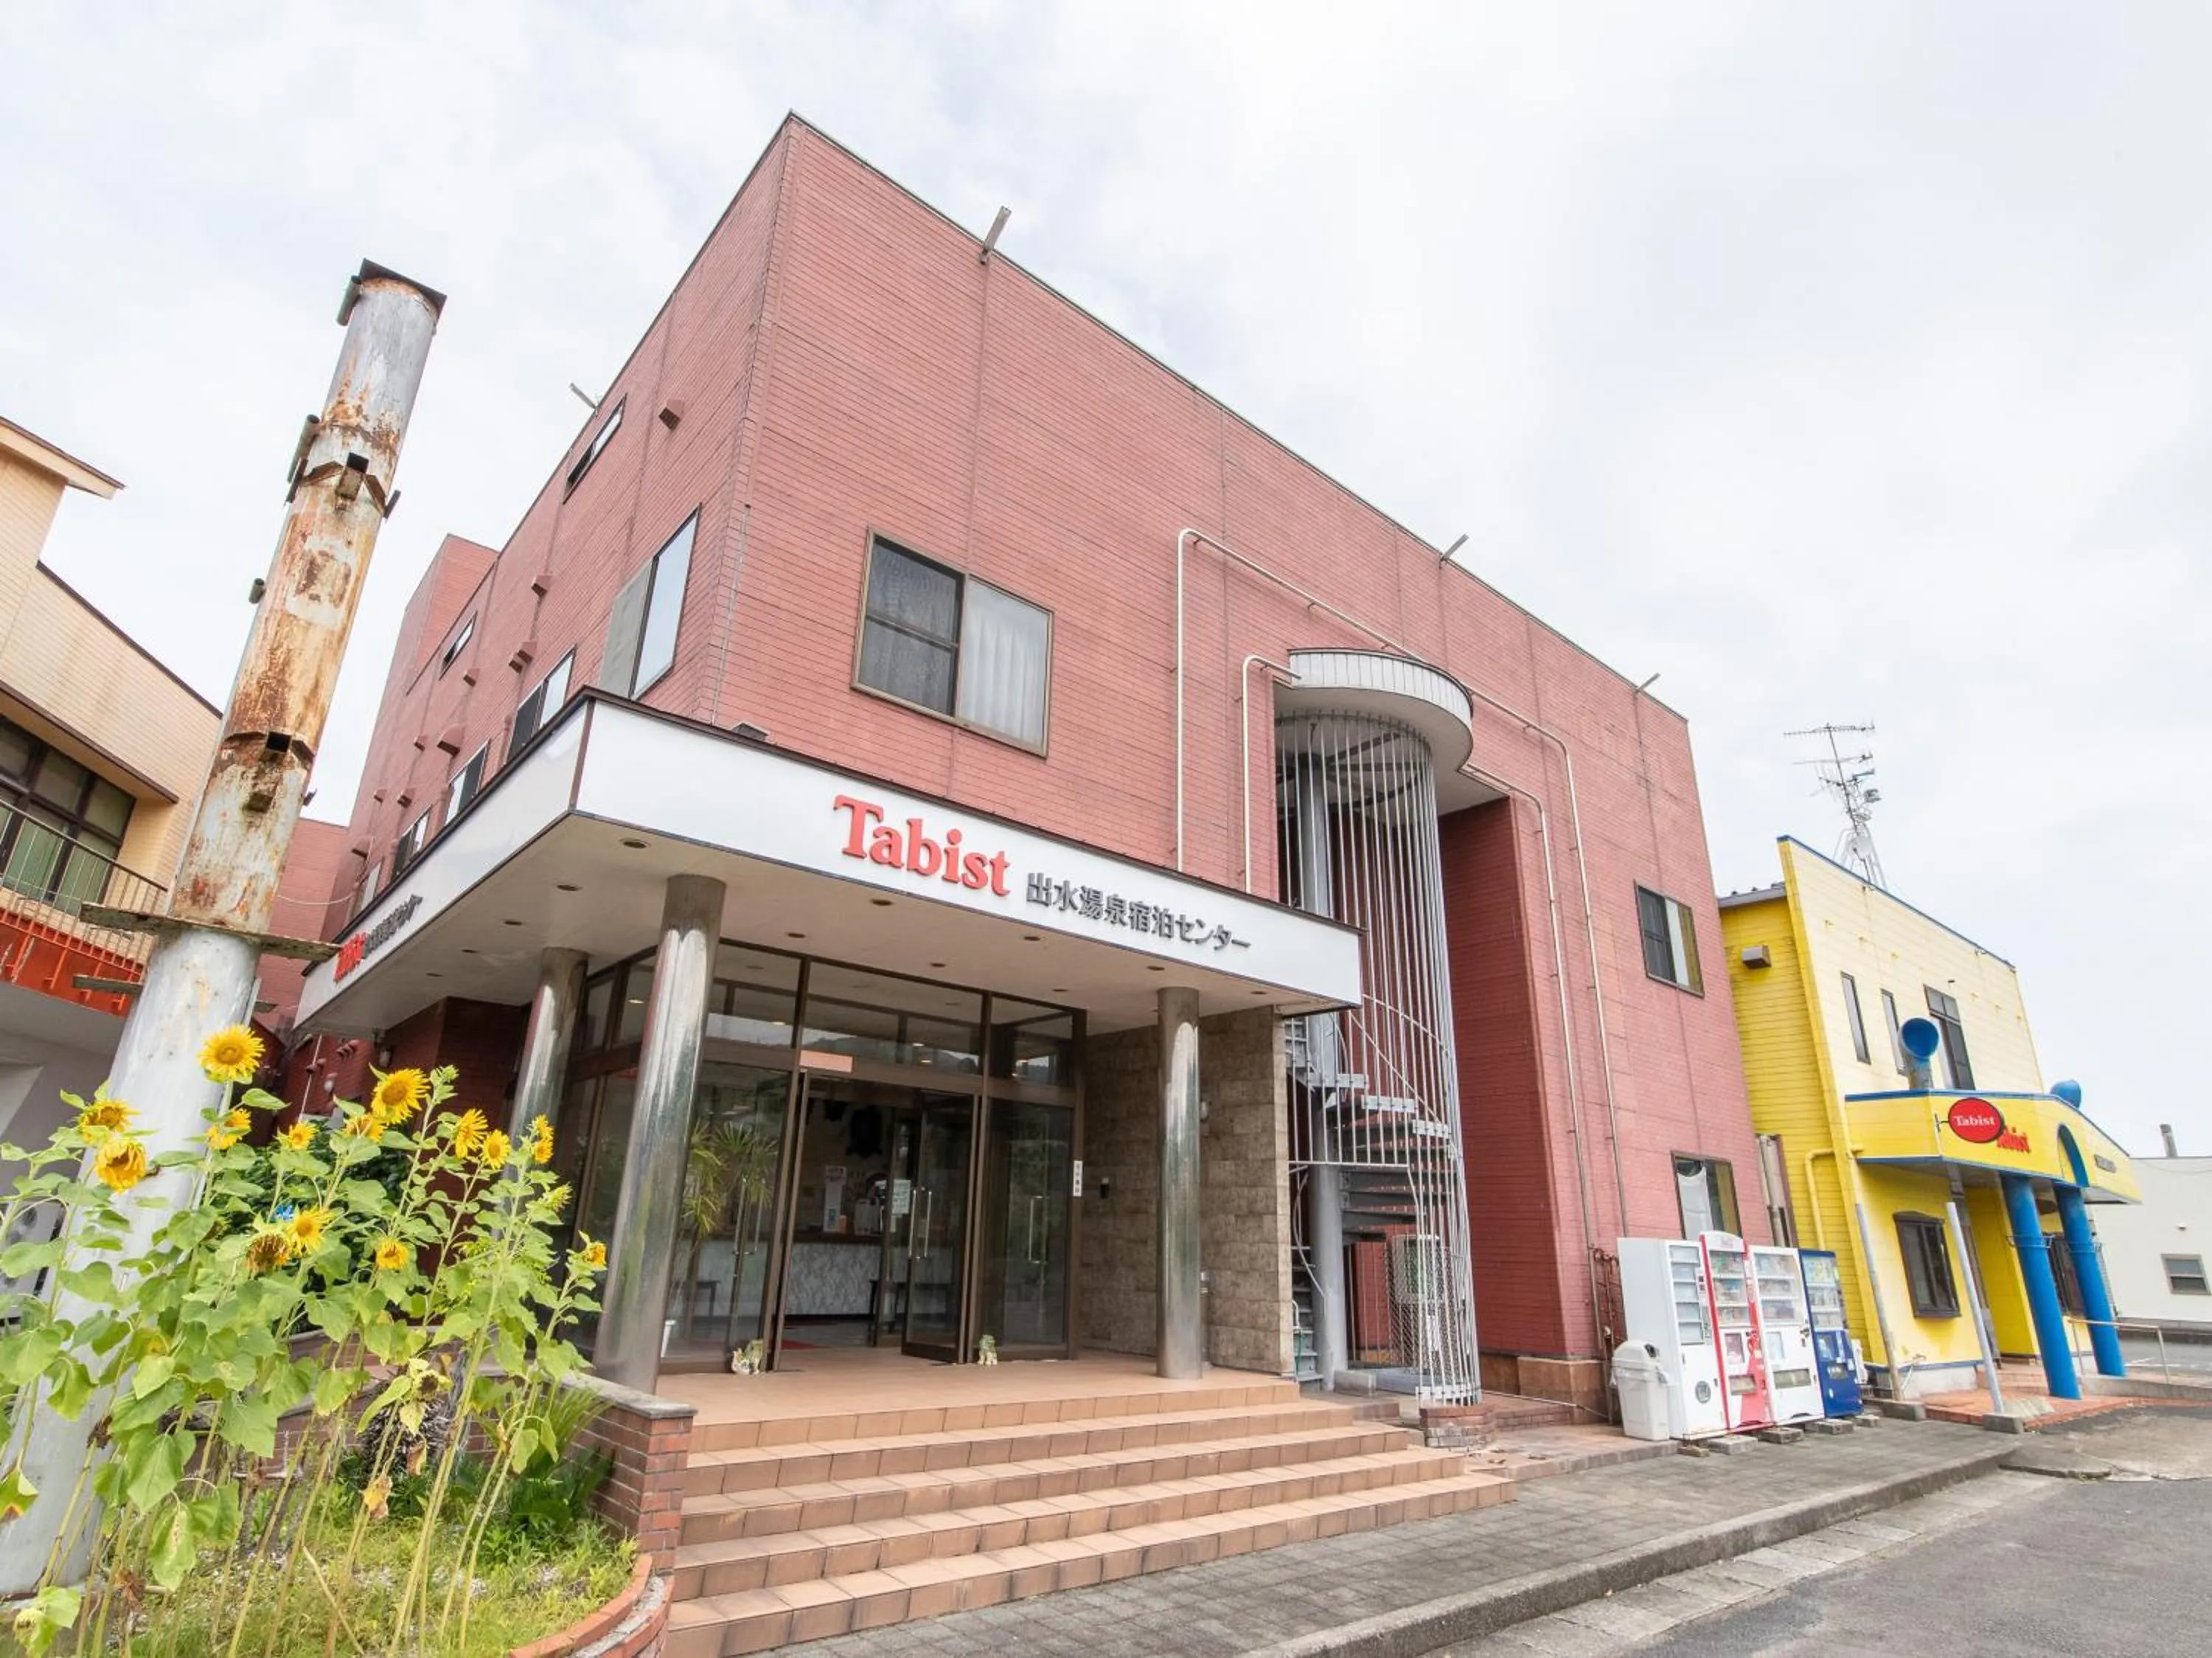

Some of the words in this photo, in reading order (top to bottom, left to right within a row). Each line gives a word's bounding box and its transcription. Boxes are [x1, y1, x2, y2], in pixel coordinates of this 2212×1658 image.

[834, 794, 1011, 896] Tabist
[1026, 873, 1251, 951] 出水湯泉宿泊センター
[1952, 1114, 1995, 1126] Tabist
